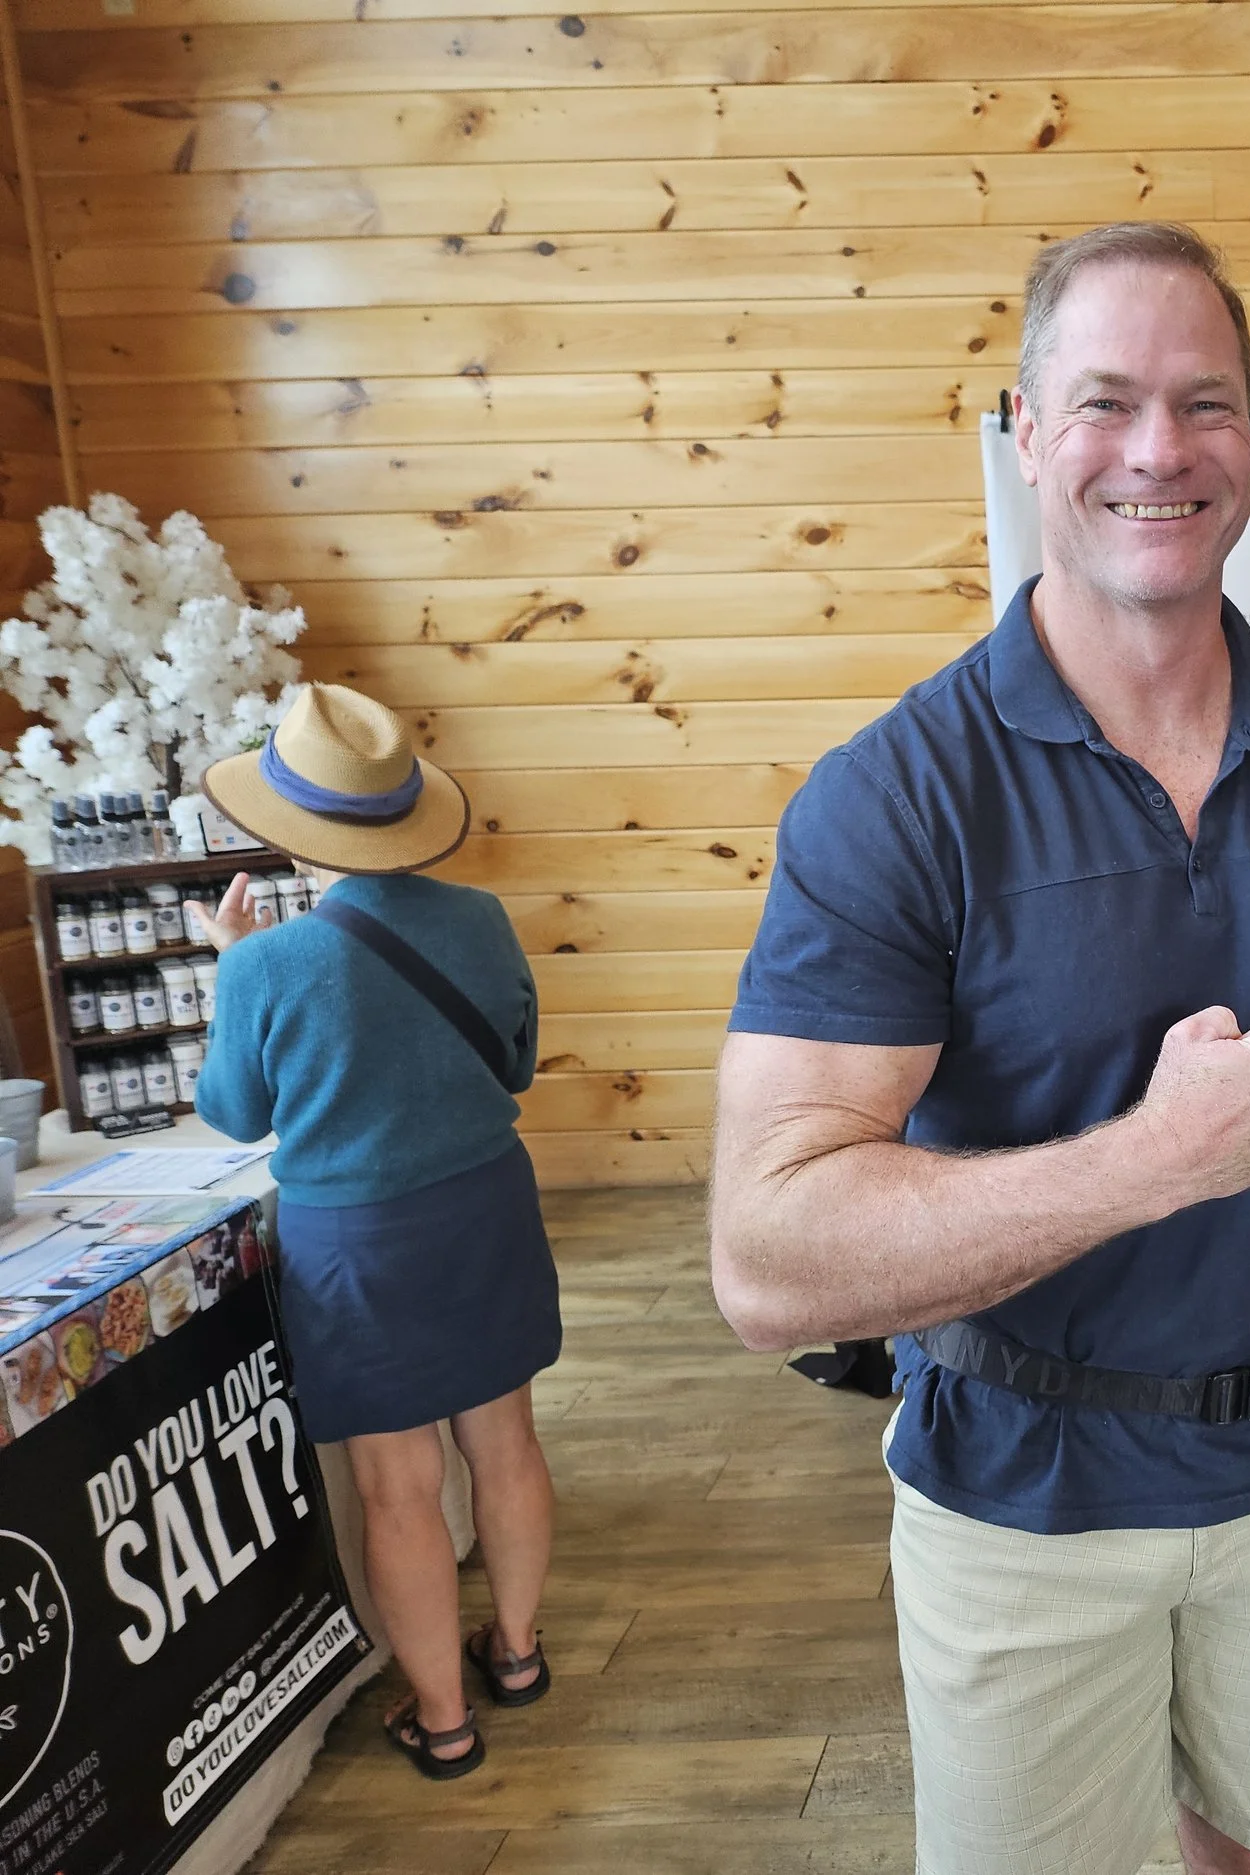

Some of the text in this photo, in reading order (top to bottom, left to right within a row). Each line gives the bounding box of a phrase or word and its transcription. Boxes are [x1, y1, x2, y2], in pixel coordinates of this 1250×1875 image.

[86, 1339, 284, 1537] DO YOU LOVE
[104, 1397, 310, 1665] SALT?
[52, 1750, 100, 1802] BLENDS
